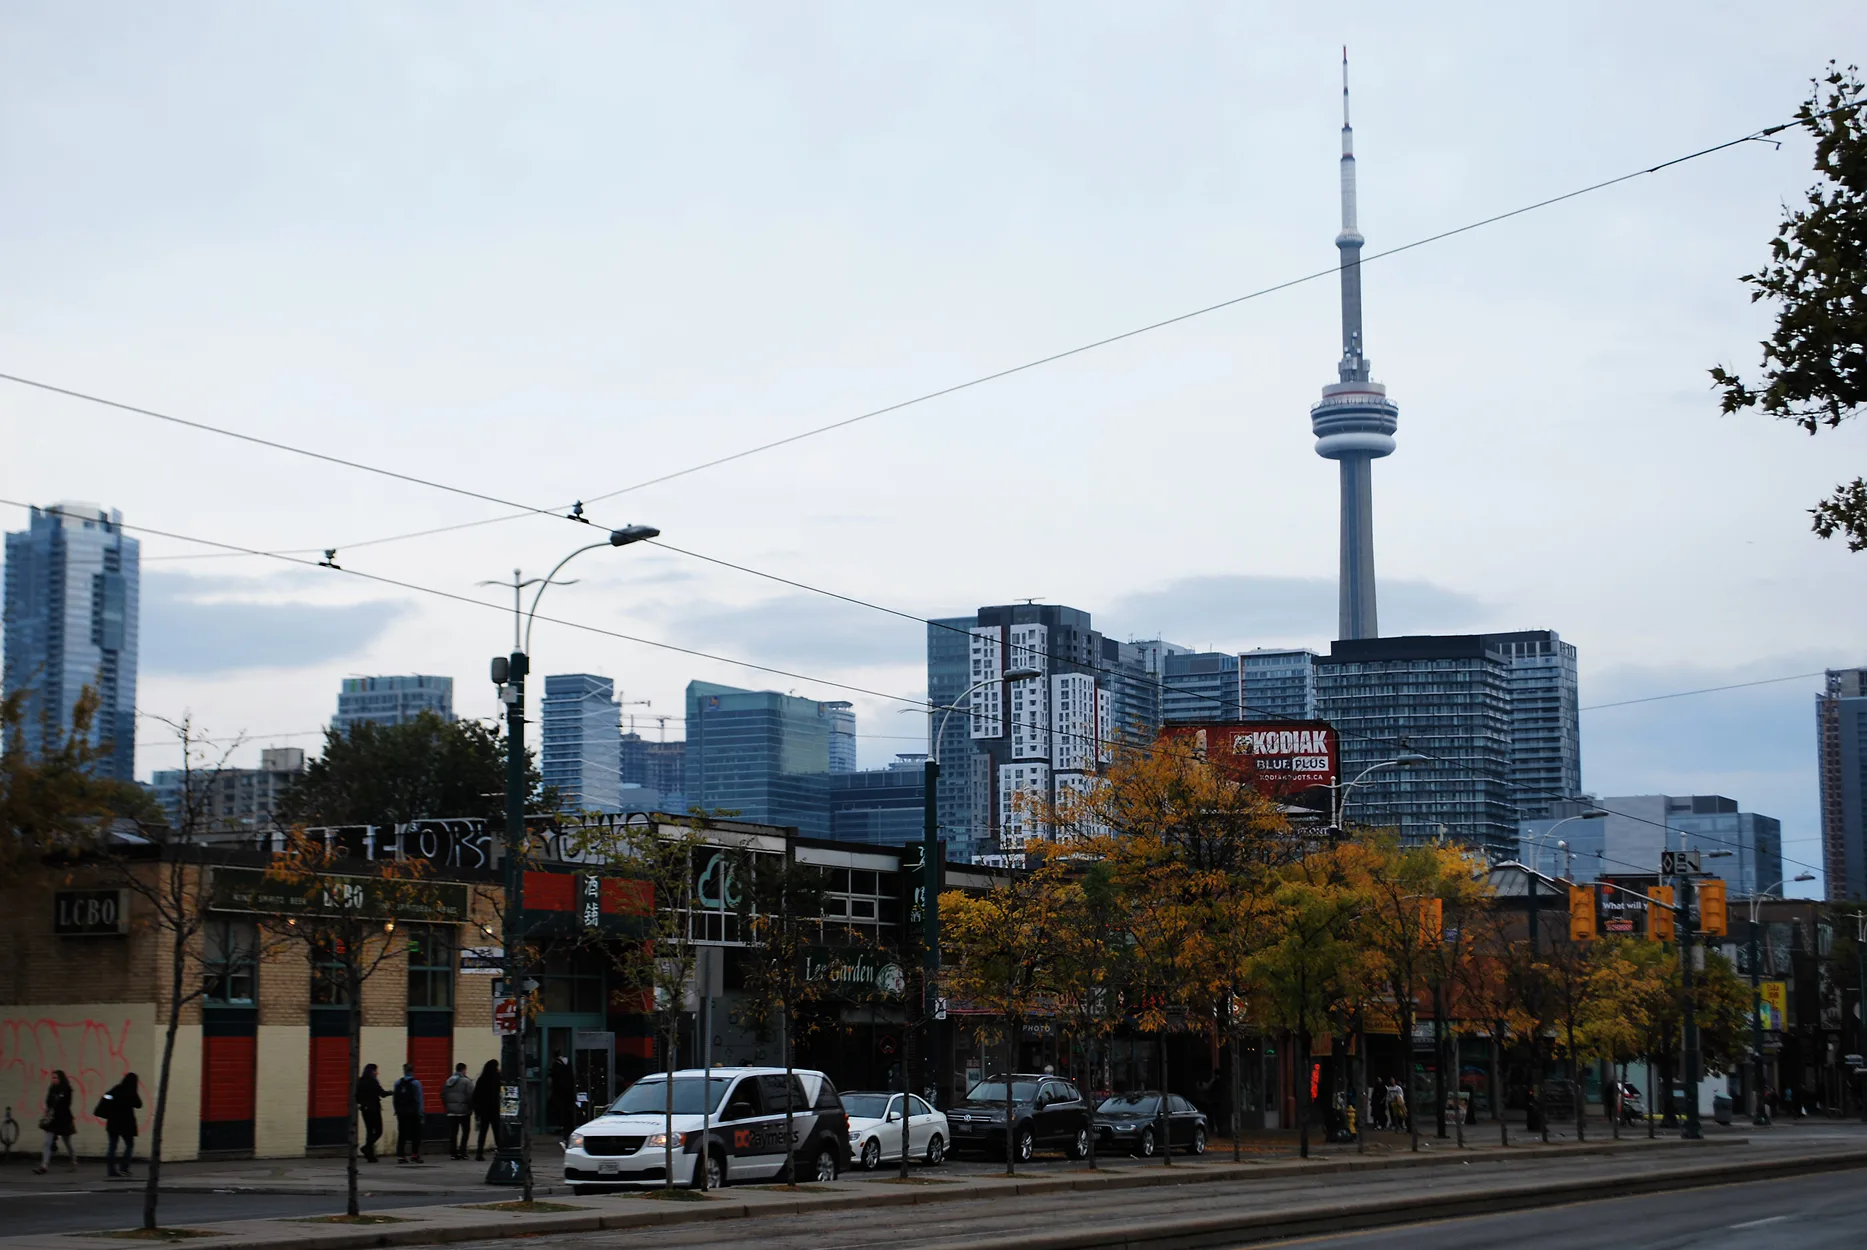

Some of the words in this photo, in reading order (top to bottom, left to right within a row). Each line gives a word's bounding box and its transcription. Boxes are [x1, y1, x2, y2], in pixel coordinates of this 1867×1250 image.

[1253, 730, 1328, 755] KODIAK
[1257, 759, 1291, 770] BLUE
[1294, 759, 1326, 769] PLUS
[1602, 901, 1625, 910] What
[1626, 901, 1642, 909] will
[59, 899, 116, 926] LCBO
[1022, 1024, 1051, 1033] PHOTO
